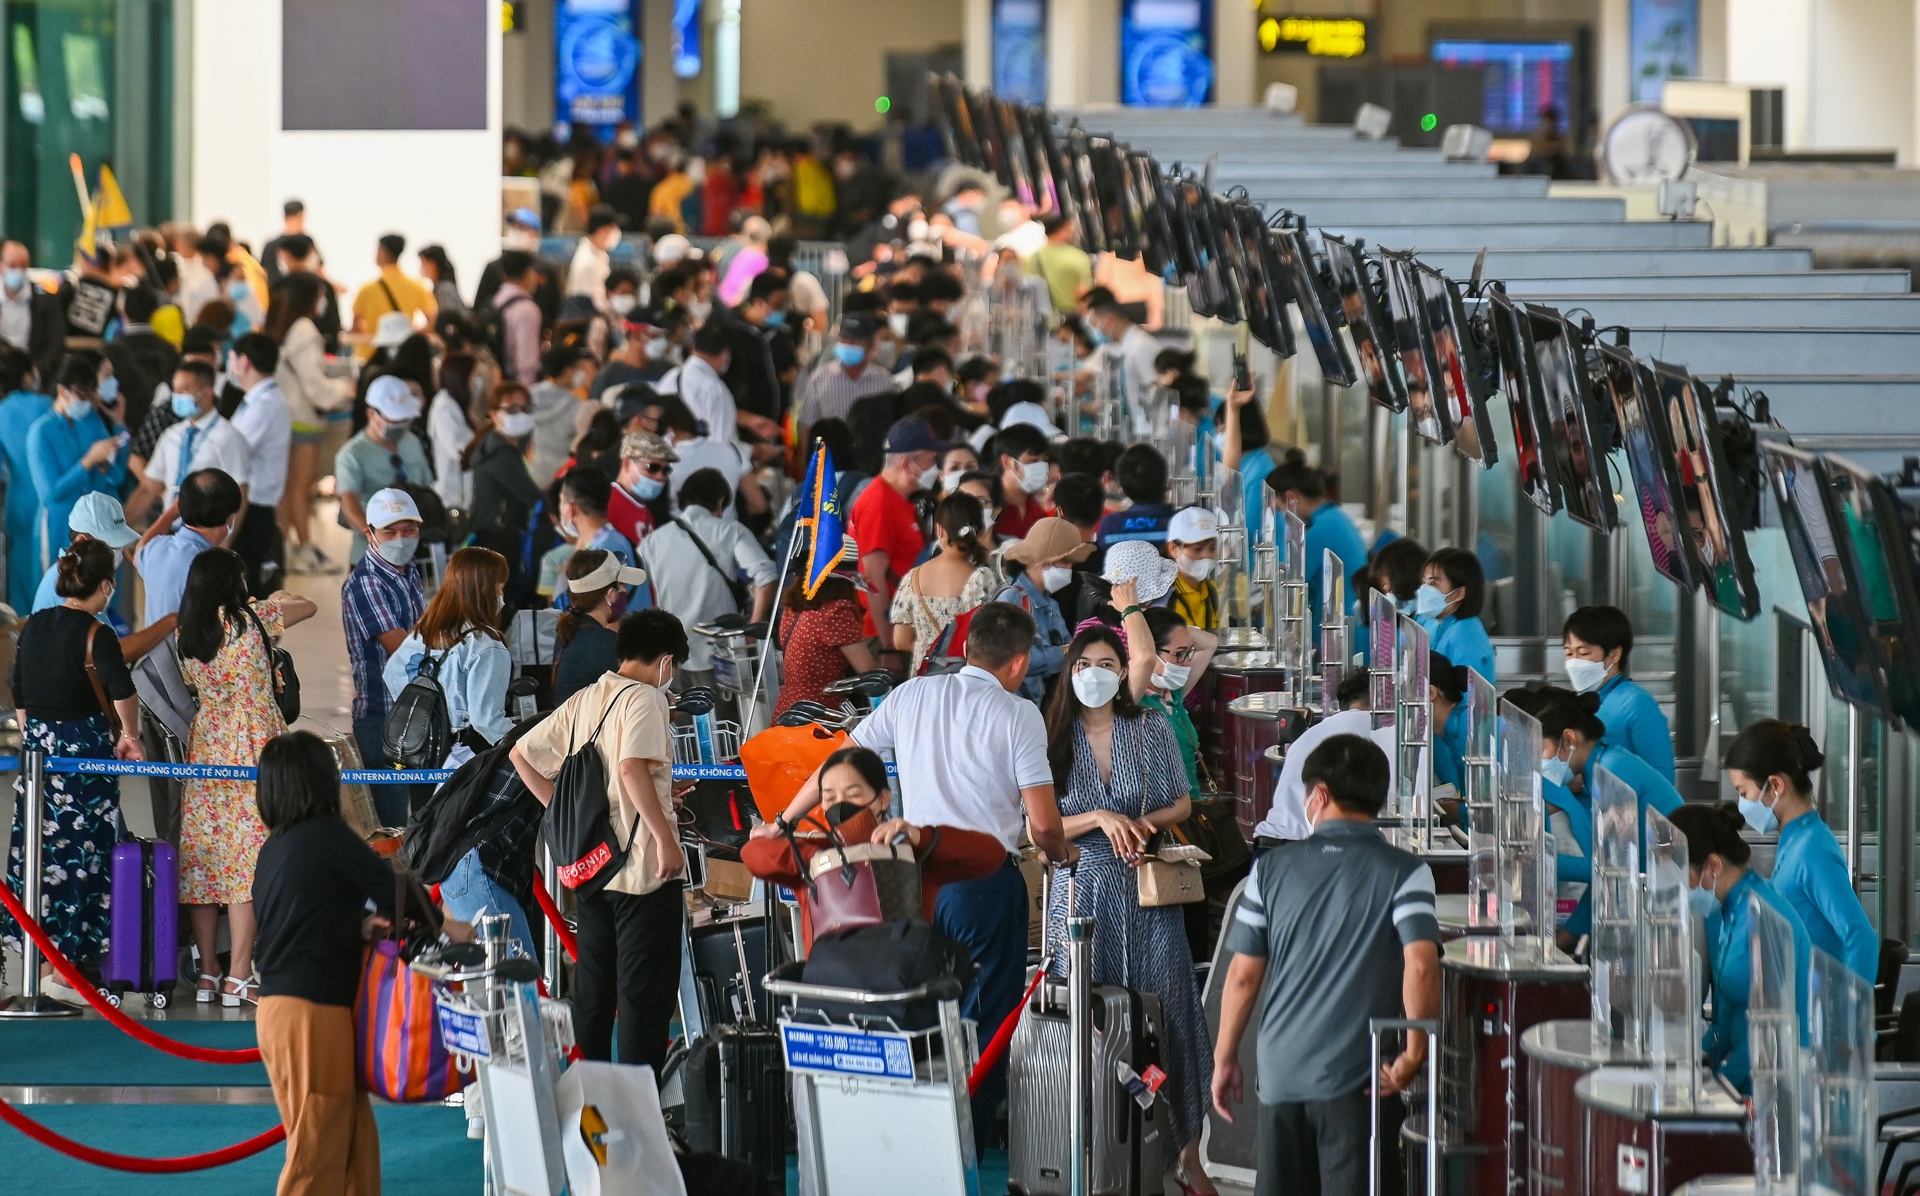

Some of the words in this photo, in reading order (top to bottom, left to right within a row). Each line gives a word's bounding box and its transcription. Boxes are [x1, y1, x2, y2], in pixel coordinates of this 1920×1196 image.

[1125, 517, 1157, 529] ACV
[78, 760, 105, 772] CẢNG
[107, 762, 135, 773] HÀNG
[137, 764, 170, 775] KHÔNG
[171, 765, 199, 776] QUỐC
[201, 766, 214, 777] TẾ
[214, 767, 231, 778] NỘI
[699, 767, 732, 777] KHÔNG
[734, 768, 747, 777] QU
[340, 772, 350, 781] AI
[352, 772, 425, 781] INTERNATIONAL
